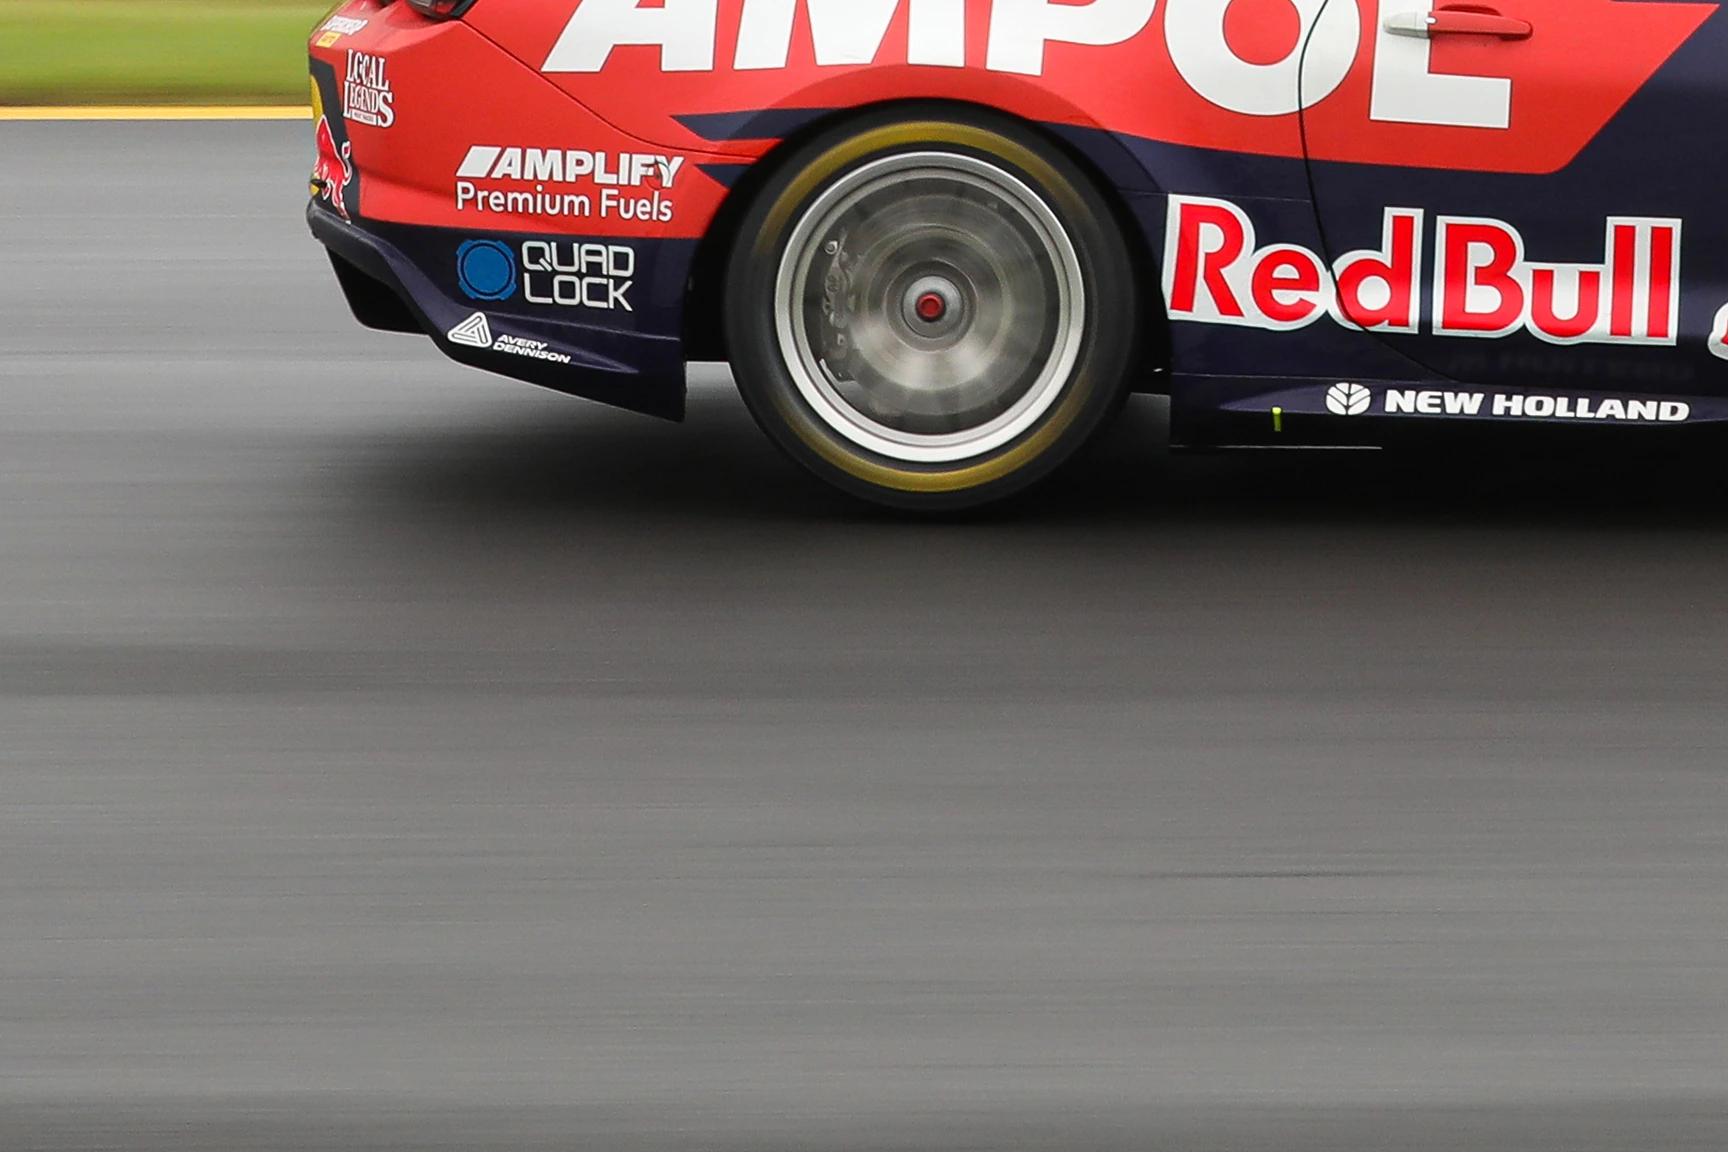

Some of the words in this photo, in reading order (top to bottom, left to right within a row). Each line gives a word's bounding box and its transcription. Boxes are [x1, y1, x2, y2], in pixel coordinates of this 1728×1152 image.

[346, 49, 389, 91] LOCAL
[342, 80, 395, 128] LEGENDS
[491, 147, 685, 188] AMPLIFY
[456, 181, 590, 218] Premium
[600, 188, 673, 222] Fuels
[522, 241, 635, 277] QUAD
[1164, 196, 1423, 333] Red
[1435, 217, 1681, 344] Bull
[523, 272, 634, 311] LOCK
[493, 342, 571, 363] DENNISON
[497, 334, 548, 350] AVERY
[1384, 389, 1485, 415] NEW
[1492, 393, 1690, 421] HOLLAND
